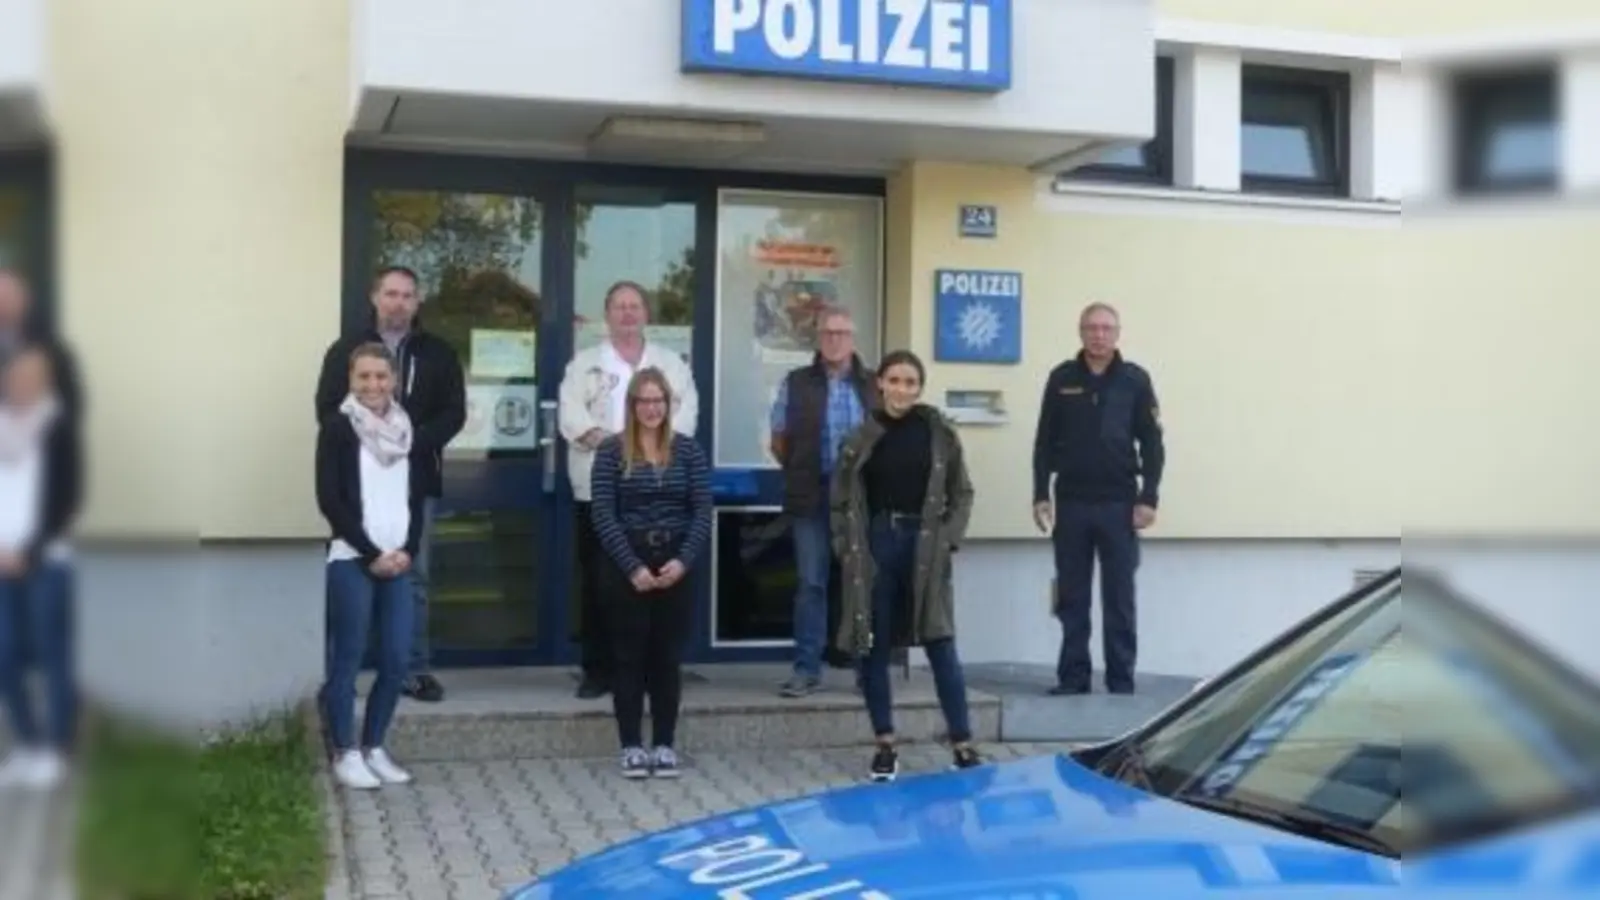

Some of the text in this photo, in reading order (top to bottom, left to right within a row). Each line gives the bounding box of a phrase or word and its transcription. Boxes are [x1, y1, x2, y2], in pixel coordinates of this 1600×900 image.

[713, 0, 989, 72] POLIZEI
[964, 206, 992, 226] 24
[940, 272, 1019, 297] POLIZEI
